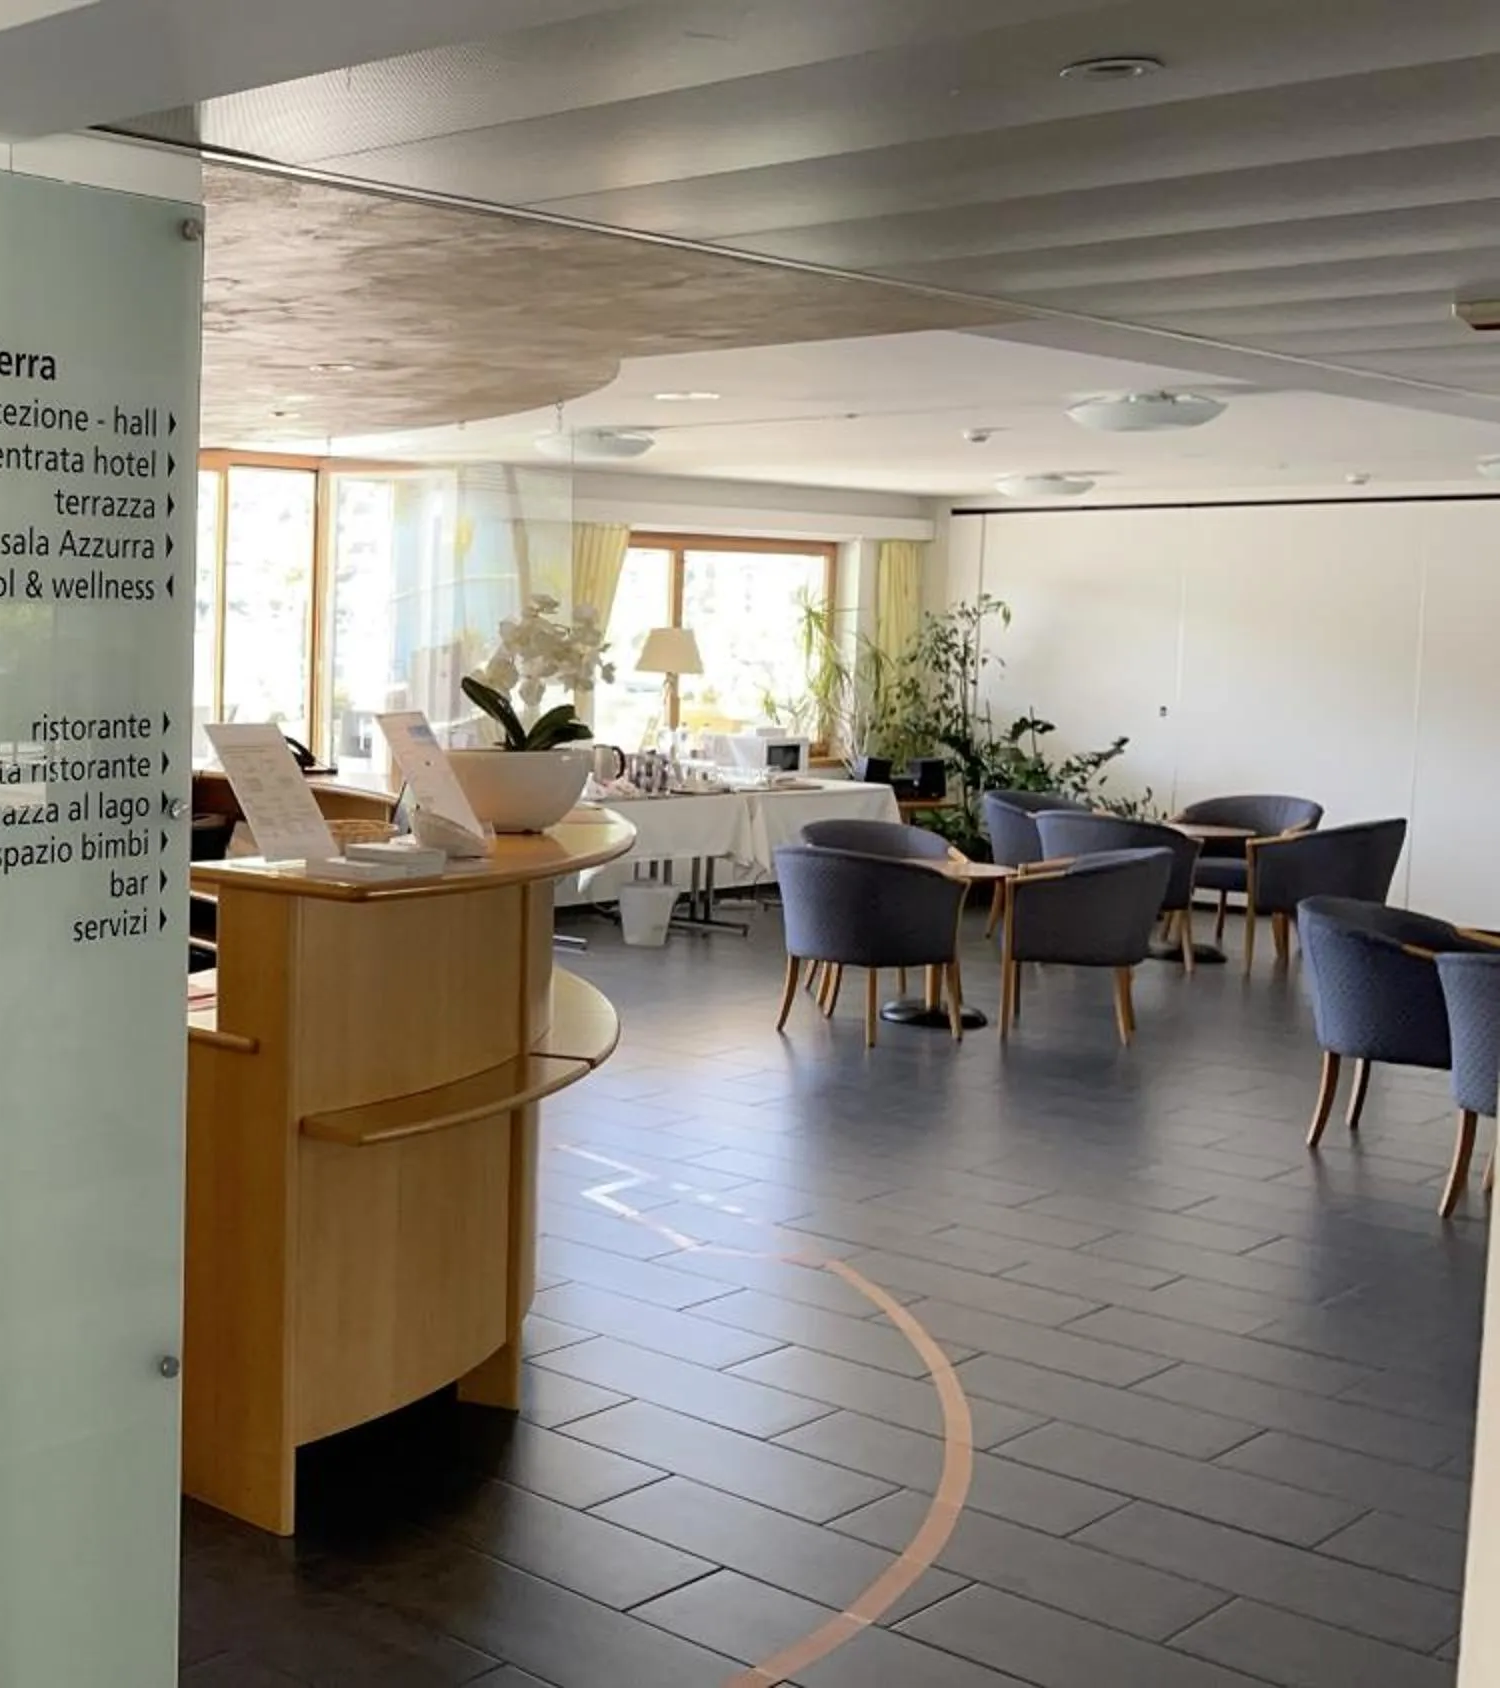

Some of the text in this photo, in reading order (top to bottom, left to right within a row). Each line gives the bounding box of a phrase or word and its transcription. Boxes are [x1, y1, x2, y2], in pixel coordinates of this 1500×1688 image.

[114, 405, 157, 437] hall
[94, 446, 157, 477] hotel
[54, 489, 156, 519] terrazza
[0, 526, 155, 559] sala Azzurra
[25, 570, 44, 597] &
[52, 570, 155, 600] wellness
[31, 713, 152, 743] ristorante
[30, 753, 152, 785] ristorante
[68, 792, 89, 822] al
[99, 792, 150, 828] lago
[81, 828, 149, 861] bimbi
[110, 869, 149, 898] bar
[73, 910, 148, 942] servizi
